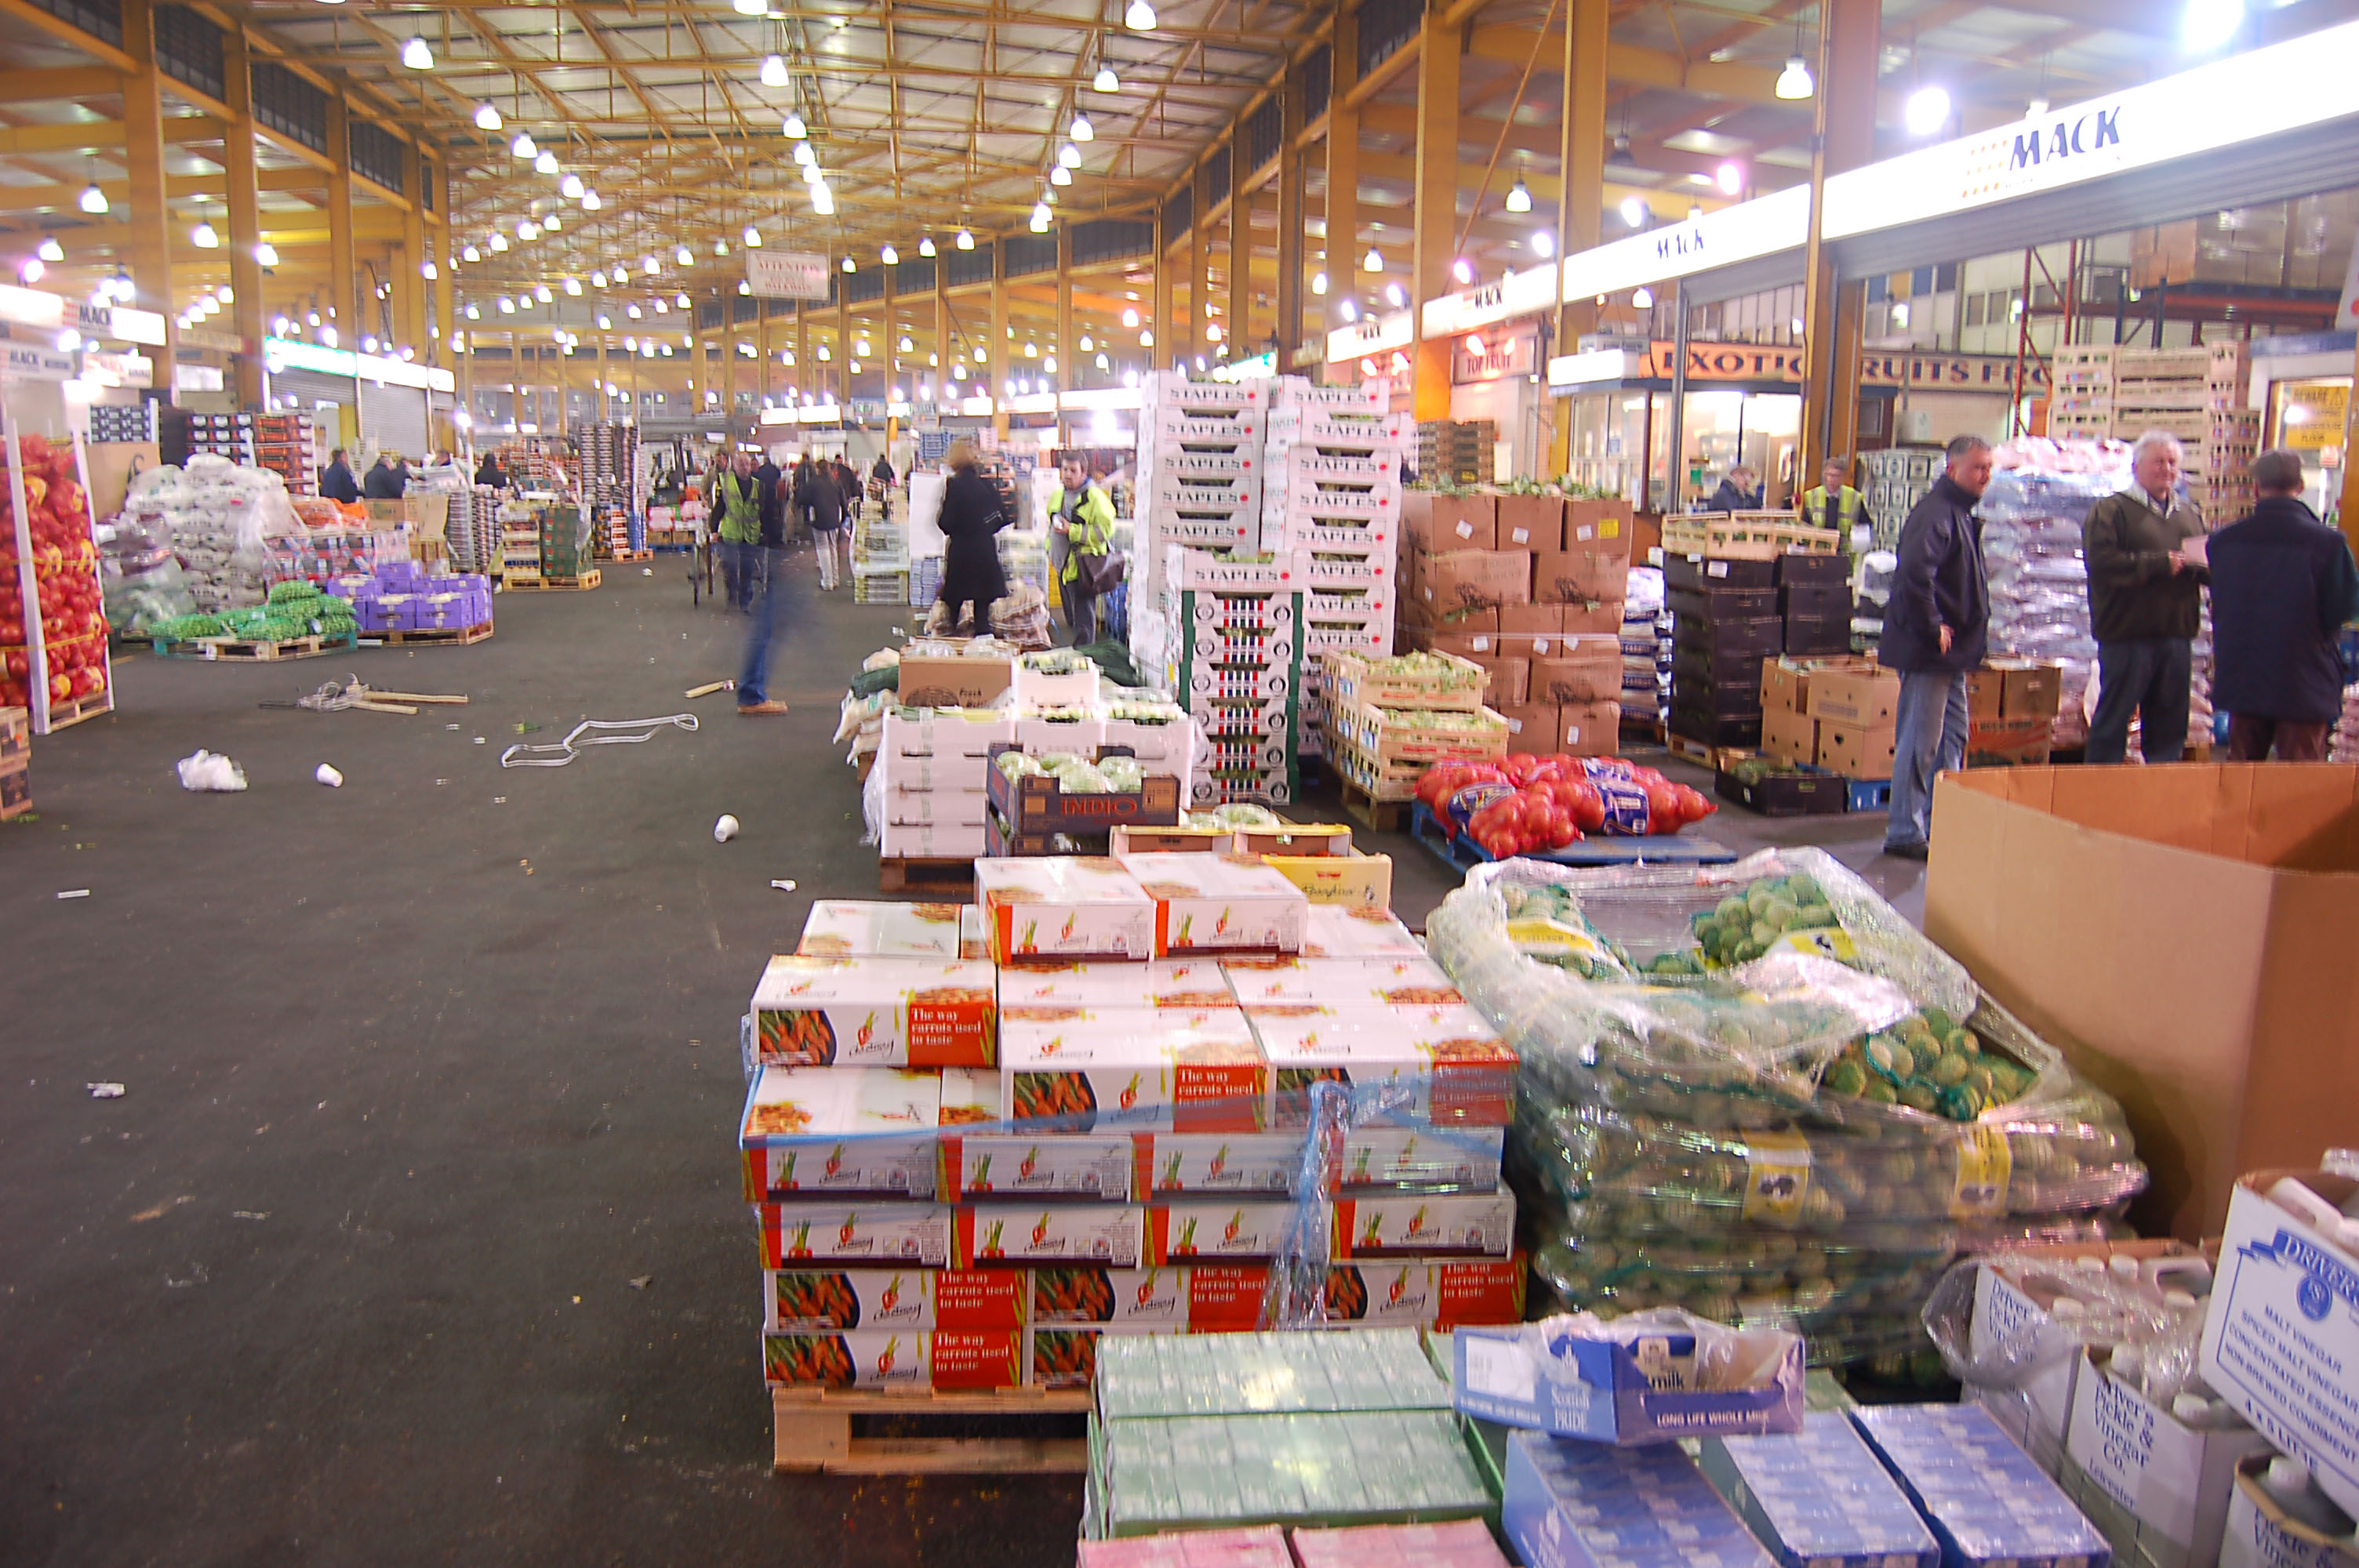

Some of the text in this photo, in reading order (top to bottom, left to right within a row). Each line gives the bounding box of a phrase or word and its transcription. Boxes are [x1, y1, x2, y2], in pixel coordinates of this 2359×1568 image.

[2009, 105, 2121, 171] MACK
[1474, 286, 1503, 310] MACK
[1863, 356, 1970, 384] RUITS
[1171, 388, 1245, 401] STAPLES
[1295, 391, 1367, 403] STAPLES
[1167, 422, 1242, 435] STAPLES
[1314, 423, 1387, 437] STAPLES
[1165, 456, 1241, 470] STAPLES
[1300, 458, 1376, 471] STAPLES
[1163, 490, 1238, 503] STAPLES
[1300, 492, 1376, 507] STAPLES
[1161, 524, 1235, 537] STAPLES
[1296, 529, 1372, 543] STAPLES
[1195, 568, 1278, 581] STAPLES
[1307, 563, 1372, 576] TAPLES
[1306, 598, 1371, 611] TAPLES
[1307, 631, 1370, 644] TAPLES
[1060, 797, 1137, 816] INDIO
[911, 1007, 958, 1024] The way
[911, 1020, 980, 1033] carrots used
[911, 1034, 953, 1046] to taste
[1180, 1069, 1229, 1085] The way
[1179, 1098, 1190, 1109] to
[1194, 1266, 1241, 1280] The way
[1445, 1262, 1491, 1276] The way
[940, 1270, 988, 1286] The way
[1194, 1276, 1267, 1290] carrots used
[1444, 1271, 1514, 1287] carrots used
[940, 1282, 1013, 1296] carrots used
[1444, 1287, 1485, 1299] to taste
[940, 1298, 983, 1309] to taste
[1194, 1291, 1236, 1303] to taste
[1993, 1275, 2034, 1322] Driver'
[935, 1331, 984, 1348] The way
[2264, 1304, 2343, 1375] MALT VINEGAR
[935, 1344, 1009, 1359] carrots used
[2229, 1320, 2306, 1396] CONCENTRATED
[936, 1360, 980, 1372] to taste
[2241, 1308, 2359, 1414] SPICED MALT VINEGAR
[1651, 1370, 1685, 1389] milk
[1550, 1384, 1590, 1411] Scottish
[2225, 1341, 2358, 1464] NON-BREWED CONDIMENT
[1554, 1409, 1589, 1434] PRIDE
[1657, 1410, 1770, 1428] LONG LIFE WHOLE MILK
[2095, 1385, 2153, 1450] Pickle &
[2095, 1409, 2150, 1468] Vinegar
[2103, 1442, 2126, 1477] Co.
[2088, 1456, 2135, 1509] Leicester
